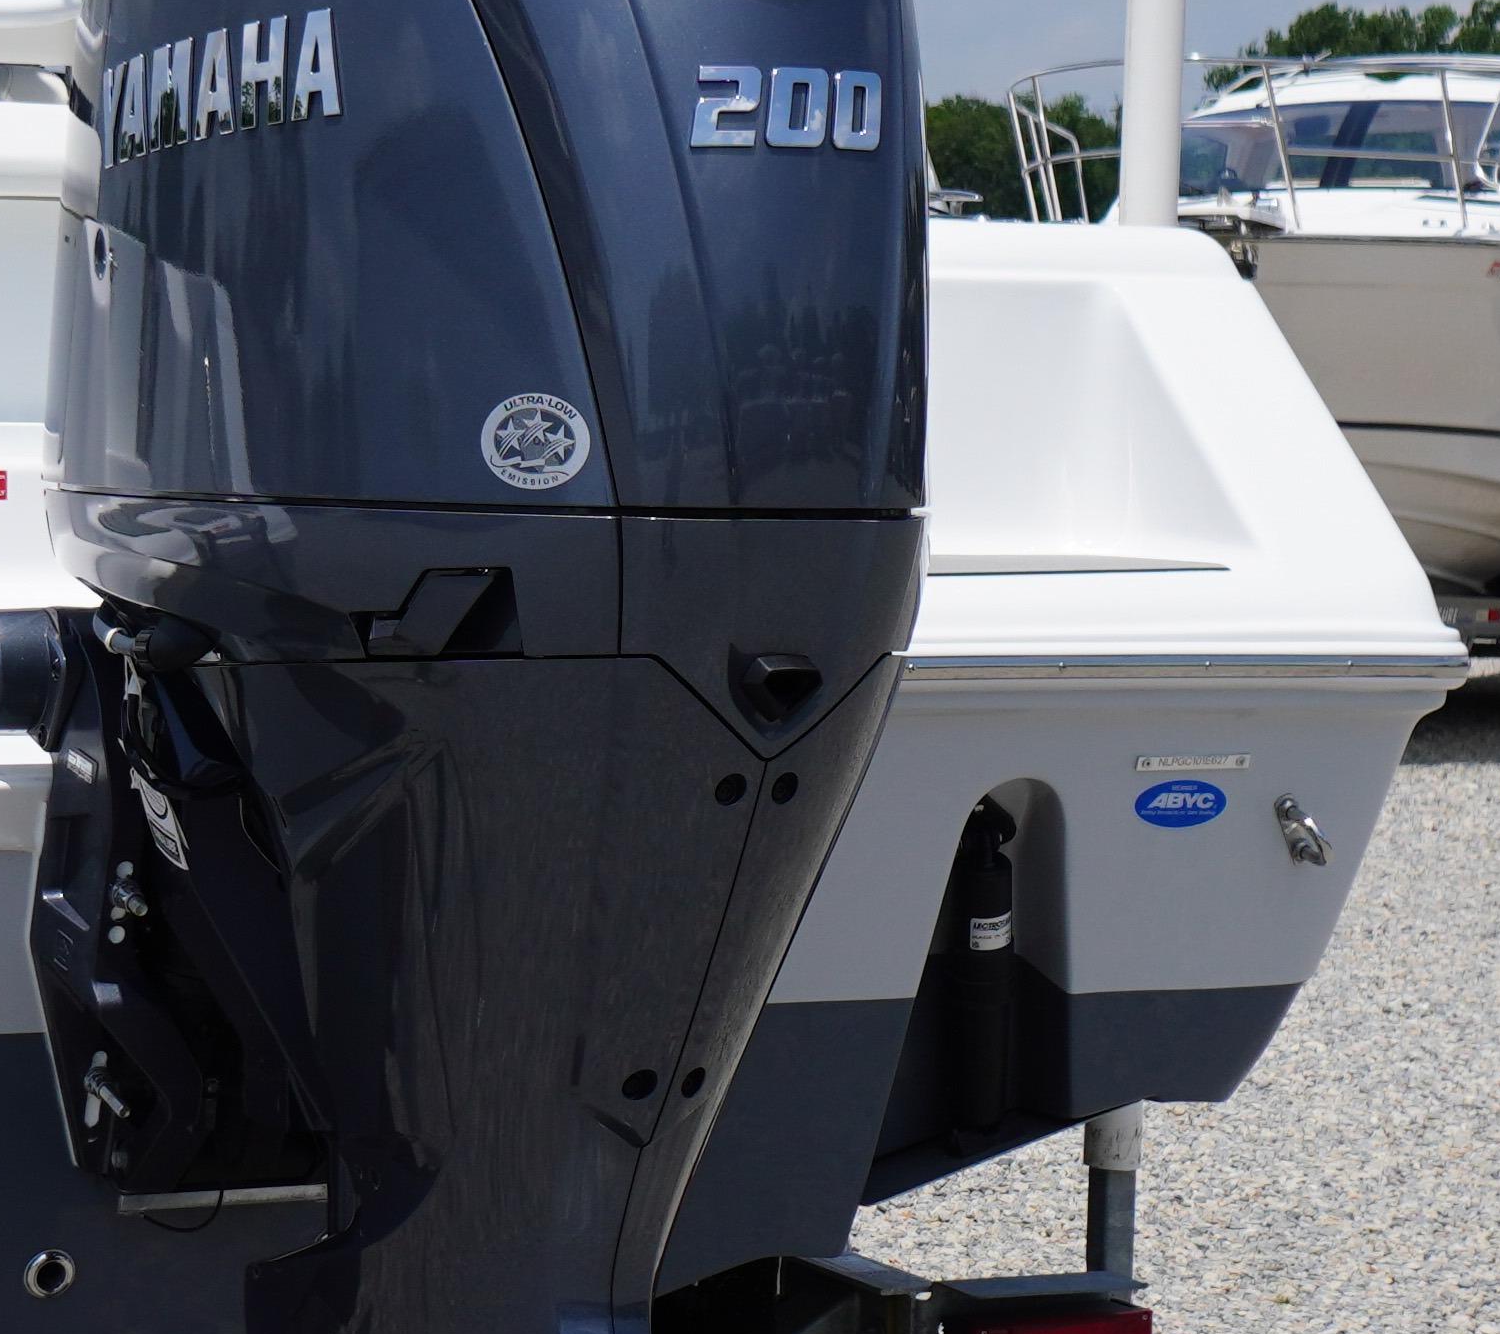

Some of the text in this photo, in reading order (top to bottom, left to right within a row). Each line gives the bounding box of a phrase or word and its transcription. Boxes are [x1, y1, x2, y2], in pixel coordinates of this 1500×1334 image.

[103, 8, 341, 169] YAMAHA
[690, 65, 882, 151] 200
[500, 469, 559, 486] EMISSION
[1146, 792, 1217, 809] ABYC
